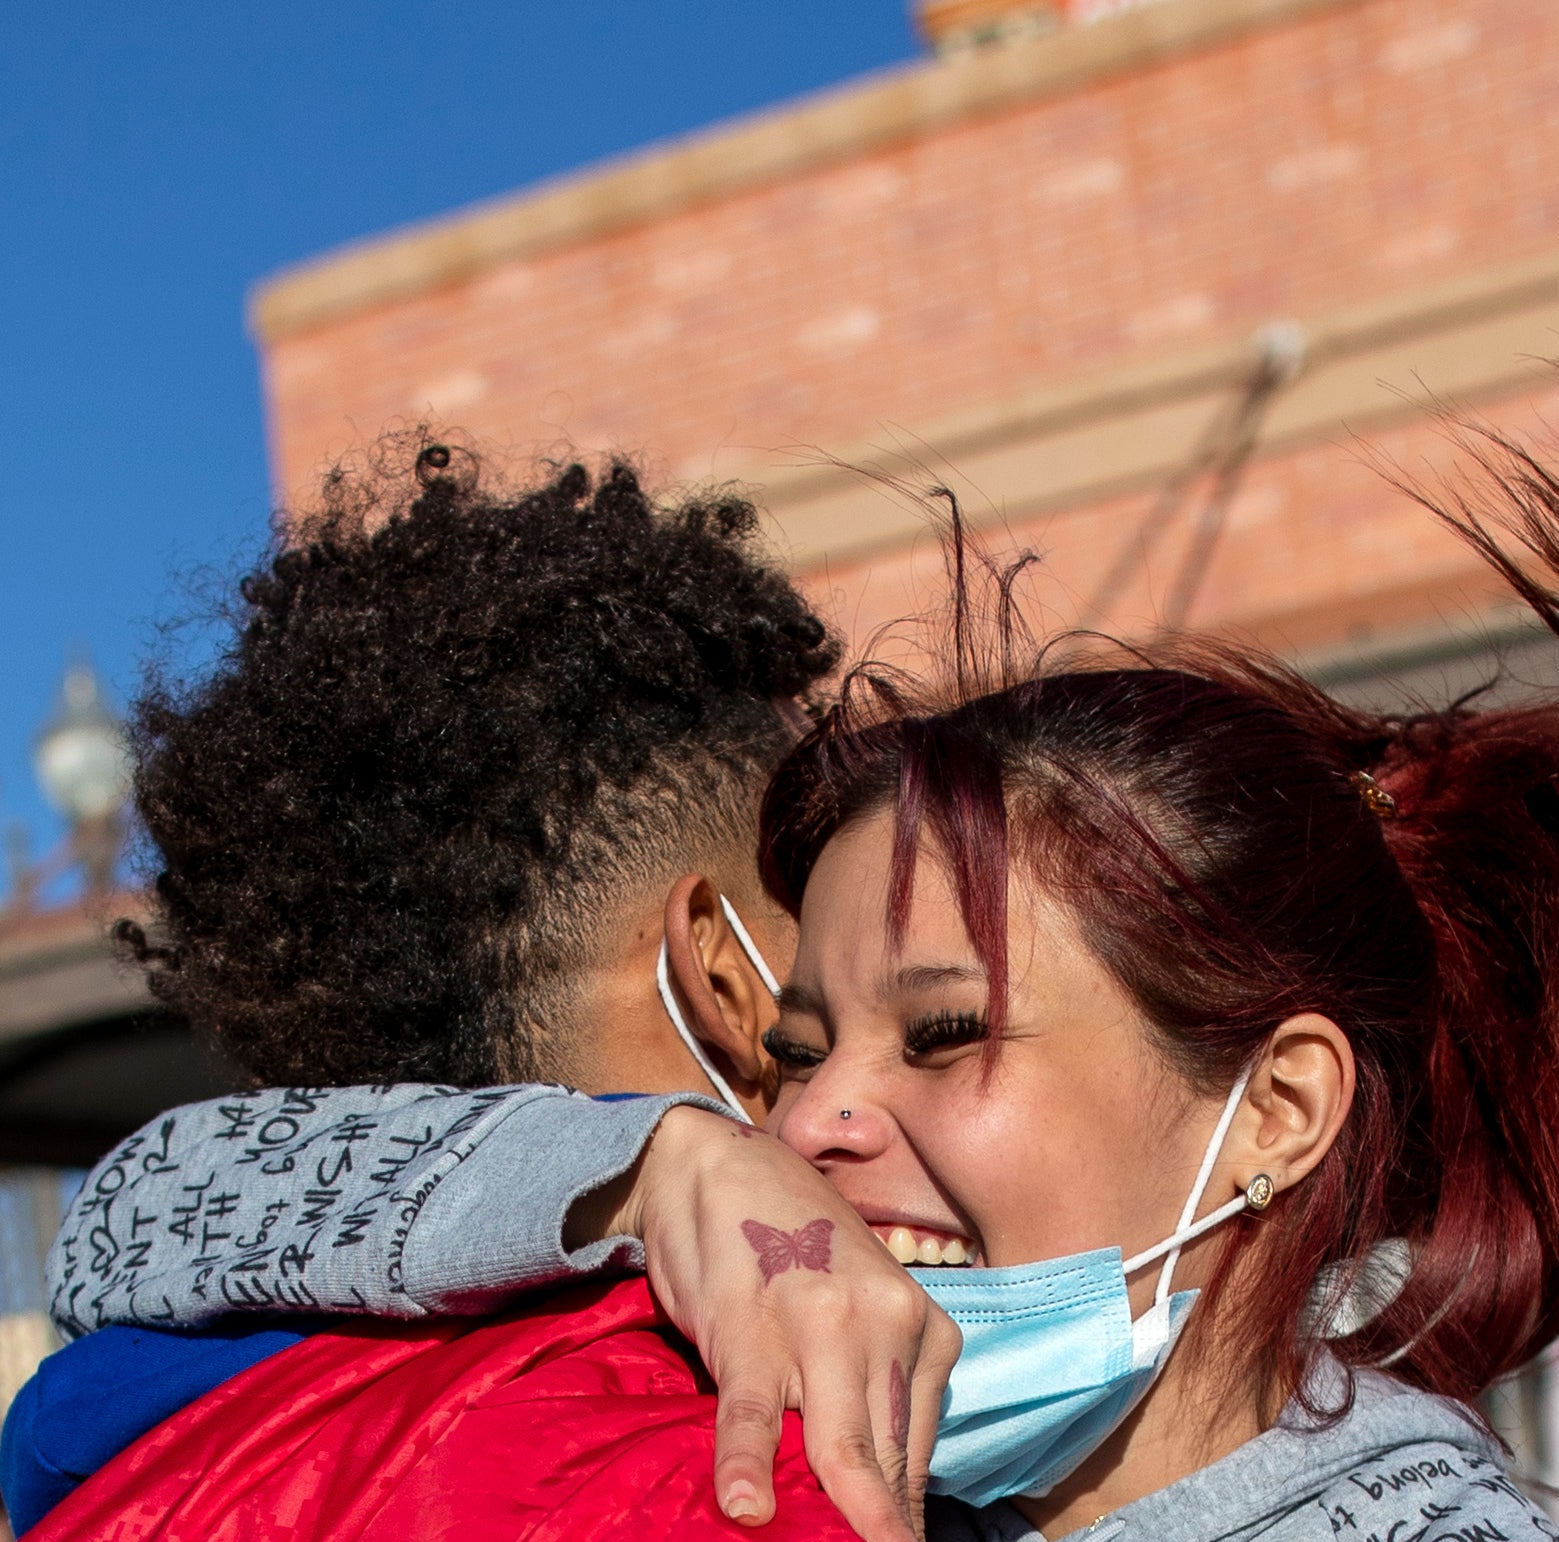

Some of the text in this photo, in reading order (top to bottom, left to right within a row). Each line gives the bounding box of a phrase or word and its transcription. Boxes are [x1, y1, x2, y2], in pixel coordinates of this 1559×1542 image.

[370, 1126, 431, 1185] ALL
[168, 1171, 216, 1246] ALL
[1348, 1458, 1462, 1500] belong
